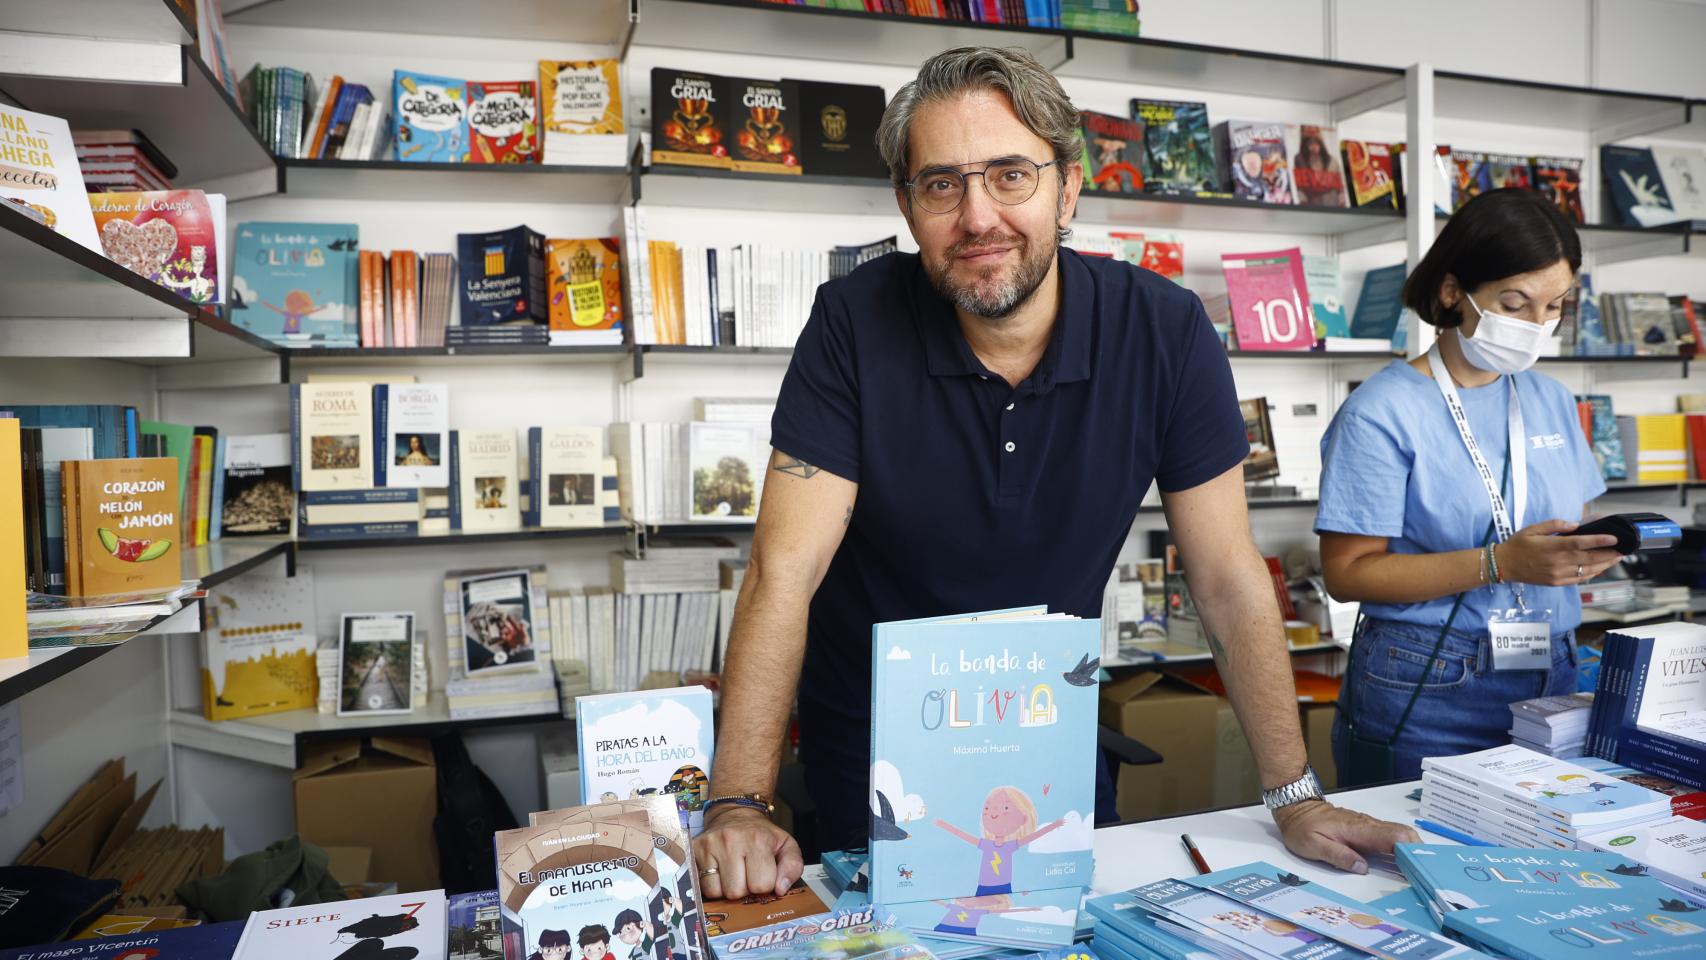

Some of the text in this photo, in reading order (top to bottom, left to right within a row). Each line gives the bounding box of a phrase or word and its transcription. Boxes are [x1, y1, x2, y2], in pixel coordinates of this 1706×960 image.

[685, 79, 711, 89] SANTO
[756, 87, 781, 96] SANTO
[580, 92, 601, 100] ROCK
[671, 84, 716, 102] GRIAL
[487, 98, 520, 112] MOLTA
[743, 93, 787, 111] GRIAL
[0, 143, 55, 168] HEGA
[91, 198, 193, 217] aderno de Corazón
[467, 275, 521, 291] La Senyera
[467, 286, 522, 302] Valenciana
[1251, 298, 1298, 344] 10
[312, 399, 357, 412] ROMA
[103, 477, 165, 495] CORAZÓN
[99, 499, 143, 514] MELÓN
[119, 511, 173, 529] JAMÓN
[1496, 636, 1510, 649] 80
[1531, 648, 1547, 656] 2021
[1669, 646, 1689, 657] JUAN
[931, 648, 1046, 676] La banda de
[1662, 657, 1706, 677] VIVES
[596, 735, 667, 751] PIRATAS A LA
[953, 743, 1020, 755] Máximo Huerta
[597, 743, 695, 768] HORA DEL BAÑO
[597, 767, 640, 778] Hugo Román
[576, 832, 601, 842] CIUDAD
[1656, 833, 1690, 845] Jugar
[400, 901, 426, 922] 7
[266, 913, 342, 930] SIETE
[728, 908, 874, 953] CRAZY CARS
[38, 946, 84, 958] mago
[88, 935, 160, 953] Vicentín
